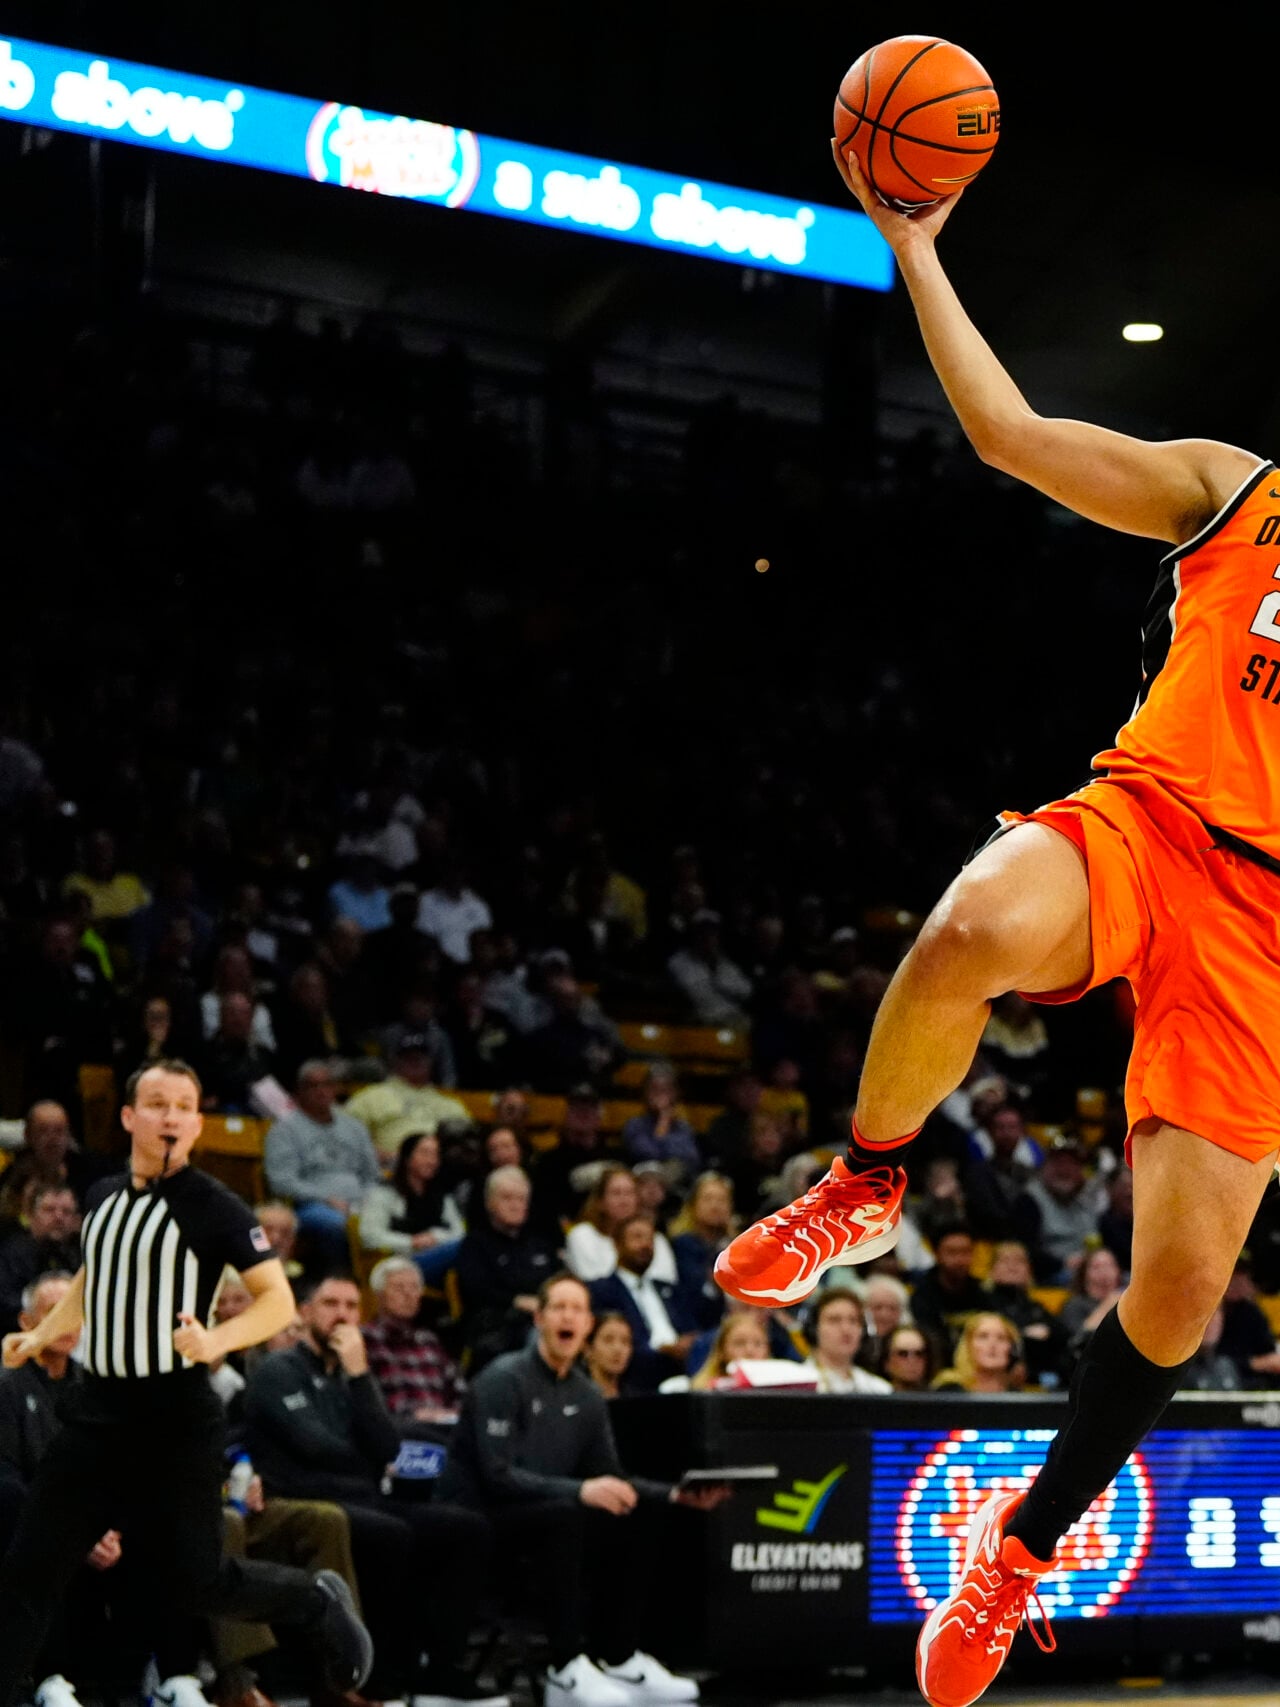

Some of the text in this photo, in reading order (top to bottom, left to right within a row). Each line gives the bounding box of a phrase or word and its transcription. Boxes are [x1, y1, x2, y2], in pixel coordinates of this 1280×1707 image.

[494, 161, 533, 211] a
[542, 166, 641, 231] sub
[731, 1542, 864, 1571] ELEVATIONS
[1186, 1498, 1236, 1568] a
